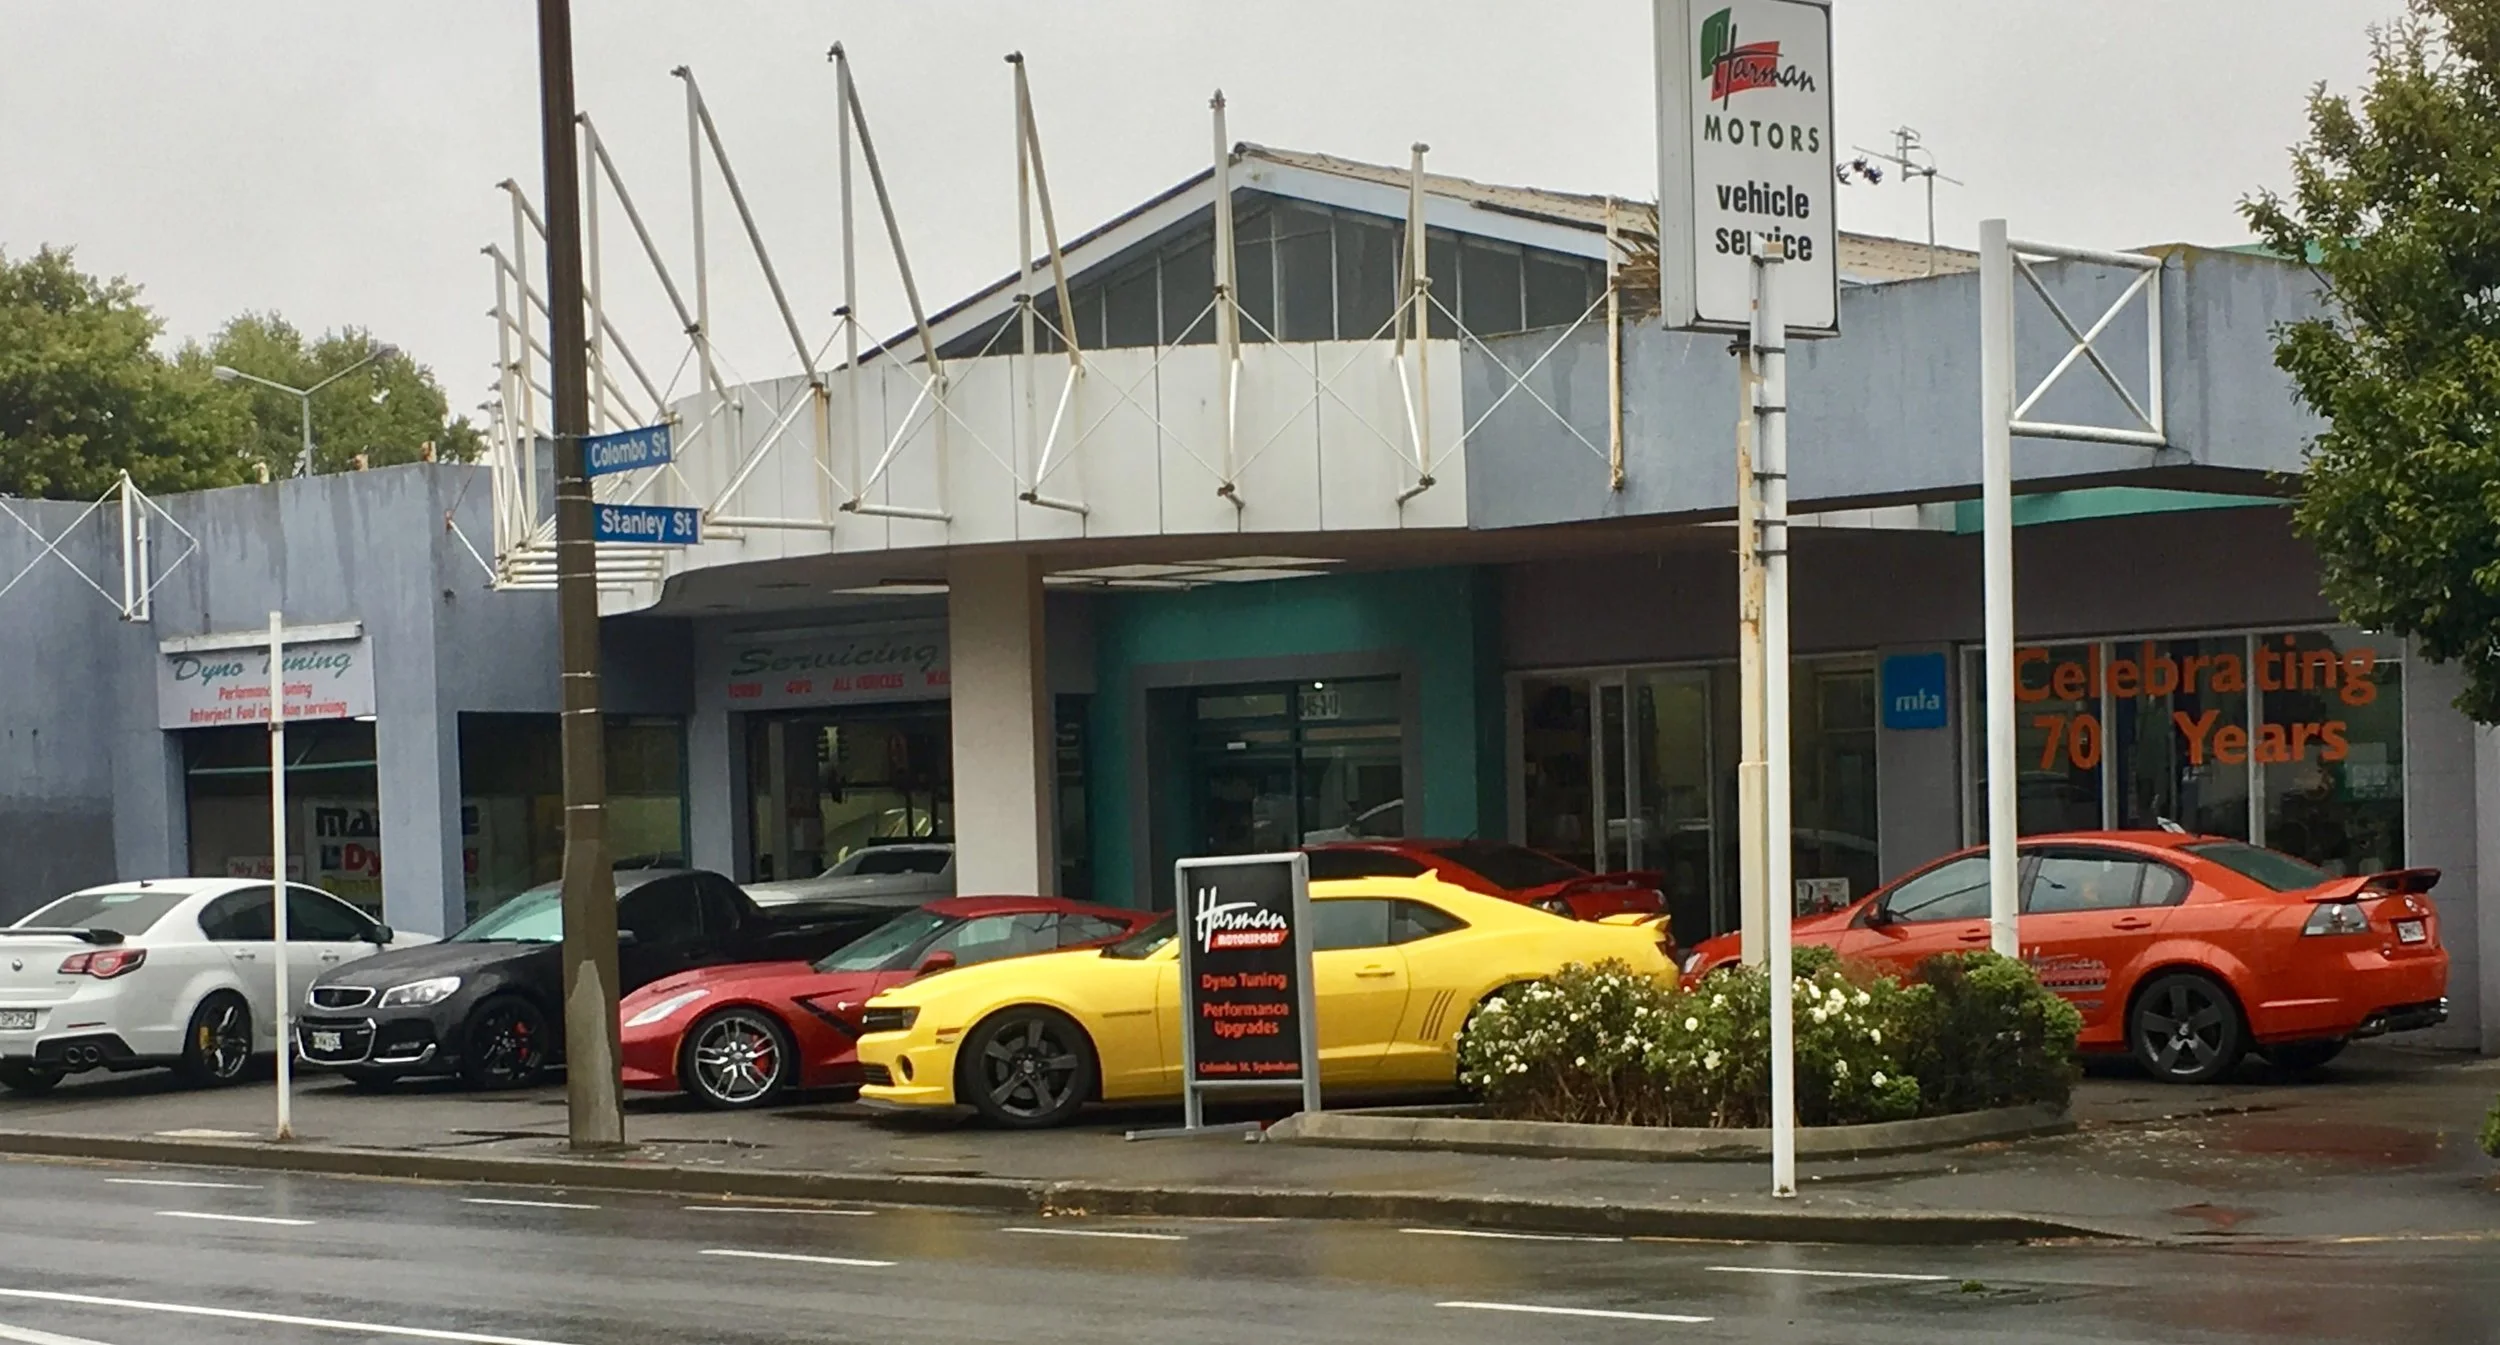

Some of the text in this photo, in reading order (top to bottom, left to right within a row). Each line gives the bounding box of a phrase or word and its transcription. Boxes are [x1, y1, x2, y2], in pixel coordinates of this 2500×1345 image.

[1711, 23, 1816, 111] Harman
[1704, 114, 1820, 153] MOTORS
[1716, 180, 1809, 219] vehicle
[591, 431, 668, 468] Colombo St
[601, 508, 693, 540] Stanley St
[173, 656, 245, 686] Dyno
[731, 642, 939, 677] Servicing
[2014, 634, 2378, 706] Celebrating
[190, 702, 232, 724] Interject
[304, 698, 347, 718] servicing
[1895, 688, 1940, 712] mta
[2032, 708, 2348, 770] 70 Years
[1195, 886, 1287, 953] Harman
[1217, 932, 1280, 946] MOTORSPORT
[1202, 972, 1287, 992] Dyno Tuning
[1203, 1001, 1289, 1017] Performance
[1214, 1020, 1279, 1038] Upgrades
